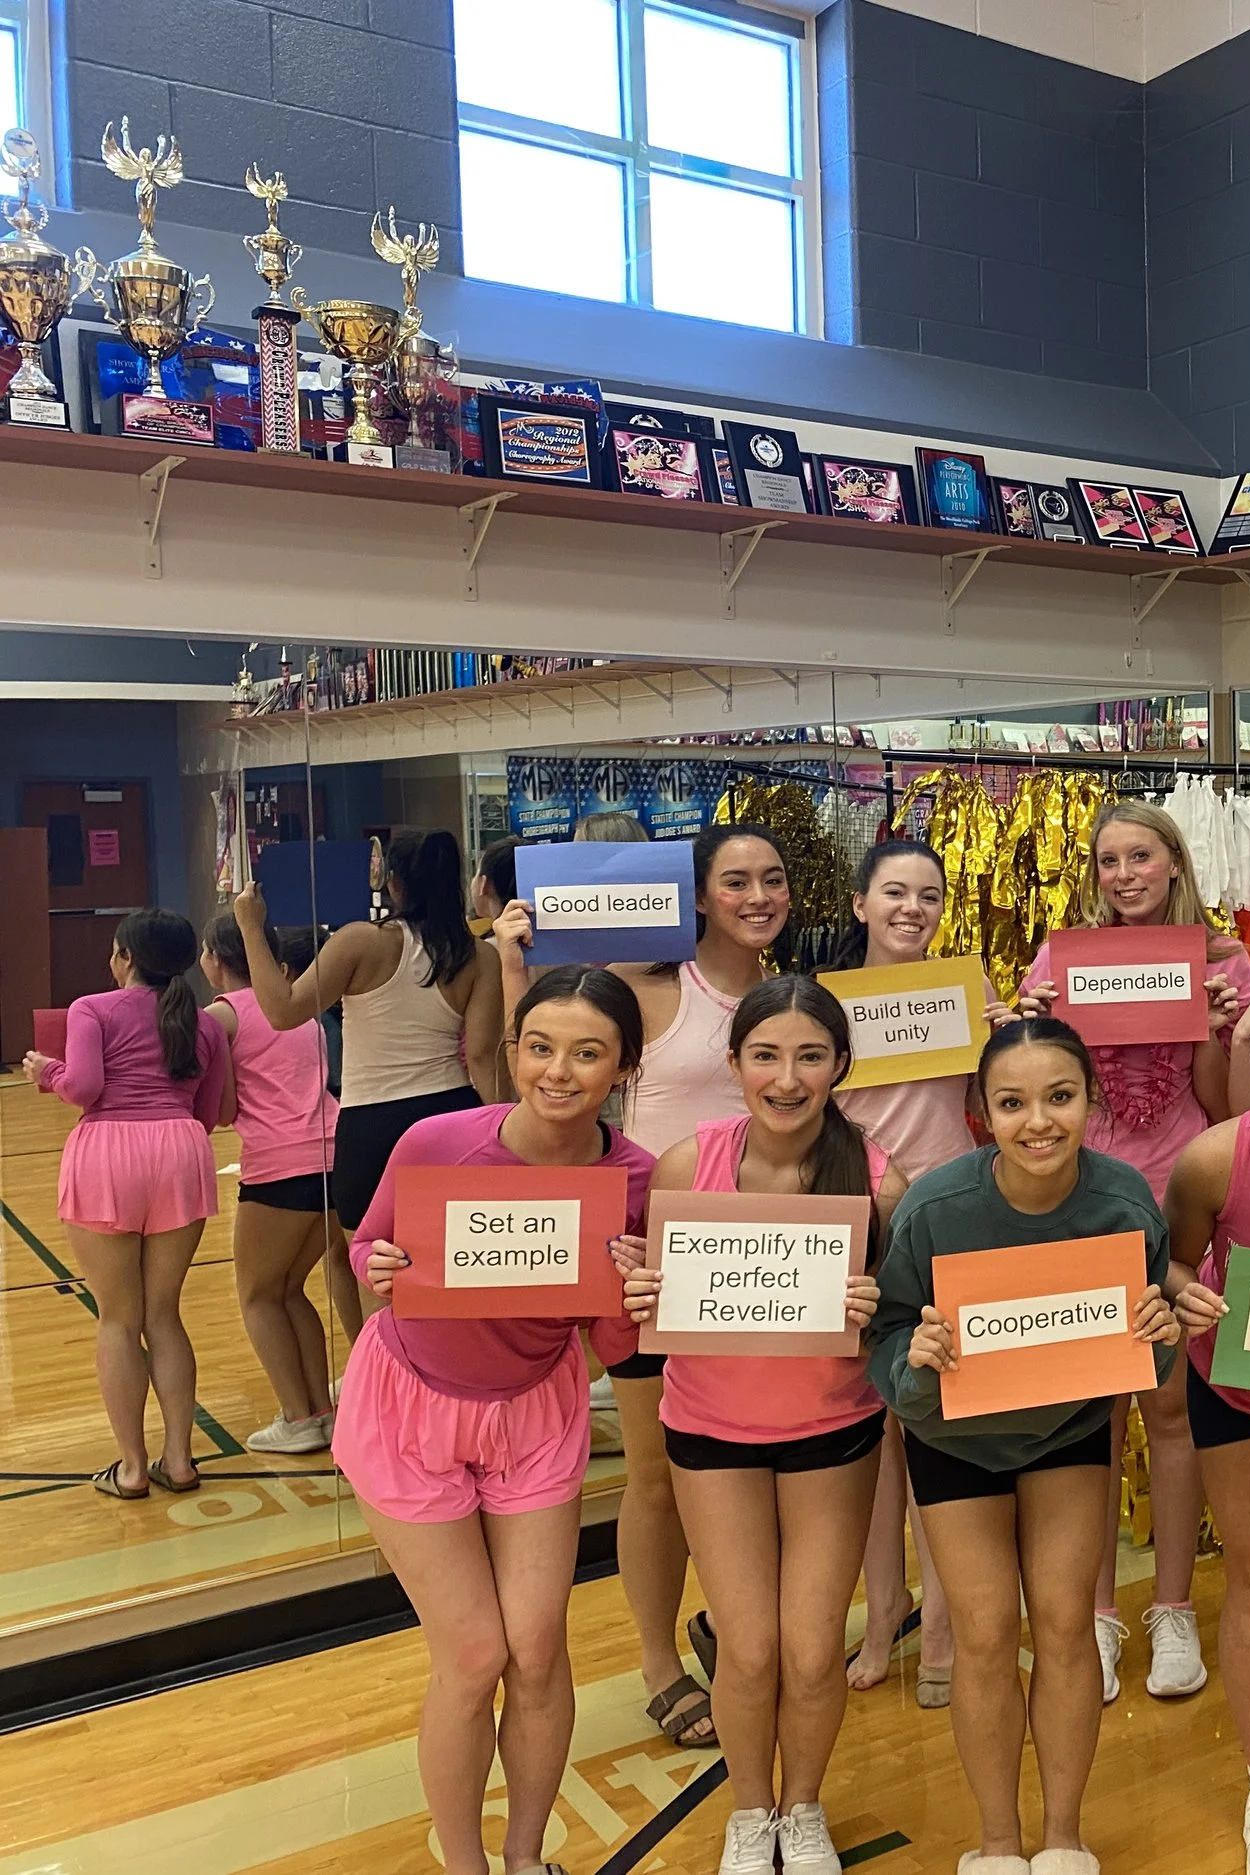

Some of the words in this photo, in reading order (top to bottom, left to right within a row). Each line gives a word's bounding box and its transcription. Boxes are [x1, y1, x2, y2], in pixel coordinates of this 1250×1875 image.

[533, 431, 581, 444] Regional
[555, 427, 579, 436] 2012
[508, 438, 580, 455] Championships
[508, 450, 555, 465] Choreography
[556, 456, 582, 466] Award
[941, 460, 966, 473] Disney
[945, 481, 969, 500] ARTS
[951, 502, 966, 511] 2010
[542, 894, 599, 913] Good
[607, 893, 672, 911] leader
[1073, 972, 1185, 993] Dependable
[853, 1000, 901, 1023] Build
[907, 999, 956, 1017] team
[884, 1024, 930, 1043] unity
[468, 1212, 514, 1234] Set
[524, 1216, 556, 1234] an
[668, 1232, 796, 1261] Exemplify
[804, 1234, 844, 1256] the
[453, 1246, 569, 1271] example
[709, 1266, 799, 1292] perfect
[698, 1299, 808, 1322] Revelier
[966, 1300, 1118, 1338] Cooperative
